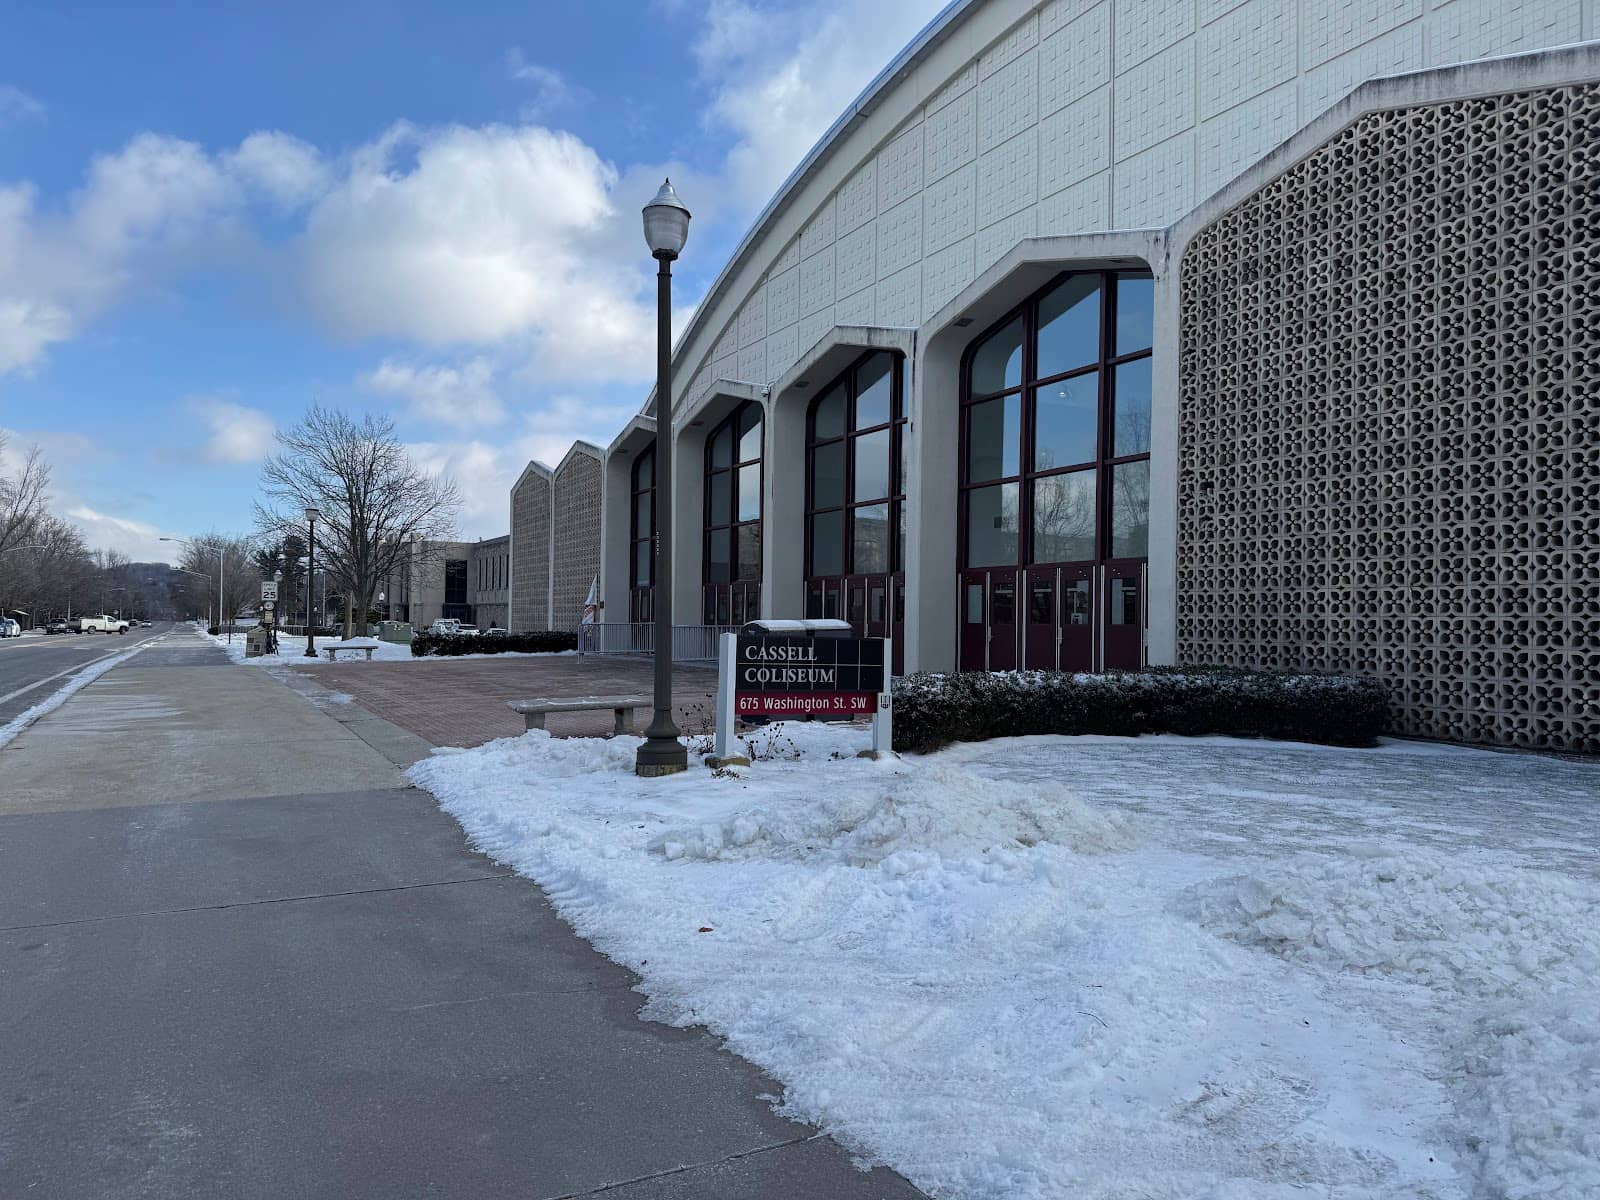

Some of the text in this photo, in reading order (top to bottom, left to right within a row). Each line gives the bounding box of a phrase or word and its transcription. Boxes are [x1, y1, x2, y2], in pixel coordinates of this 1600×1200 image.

[263, 591, 276, 599] 25
[745, 645, 818, 661] CASSELL
[744, 667, 835, 683] COLISEUM
[740, 696, 866, 712] 675 Washington St. SW
